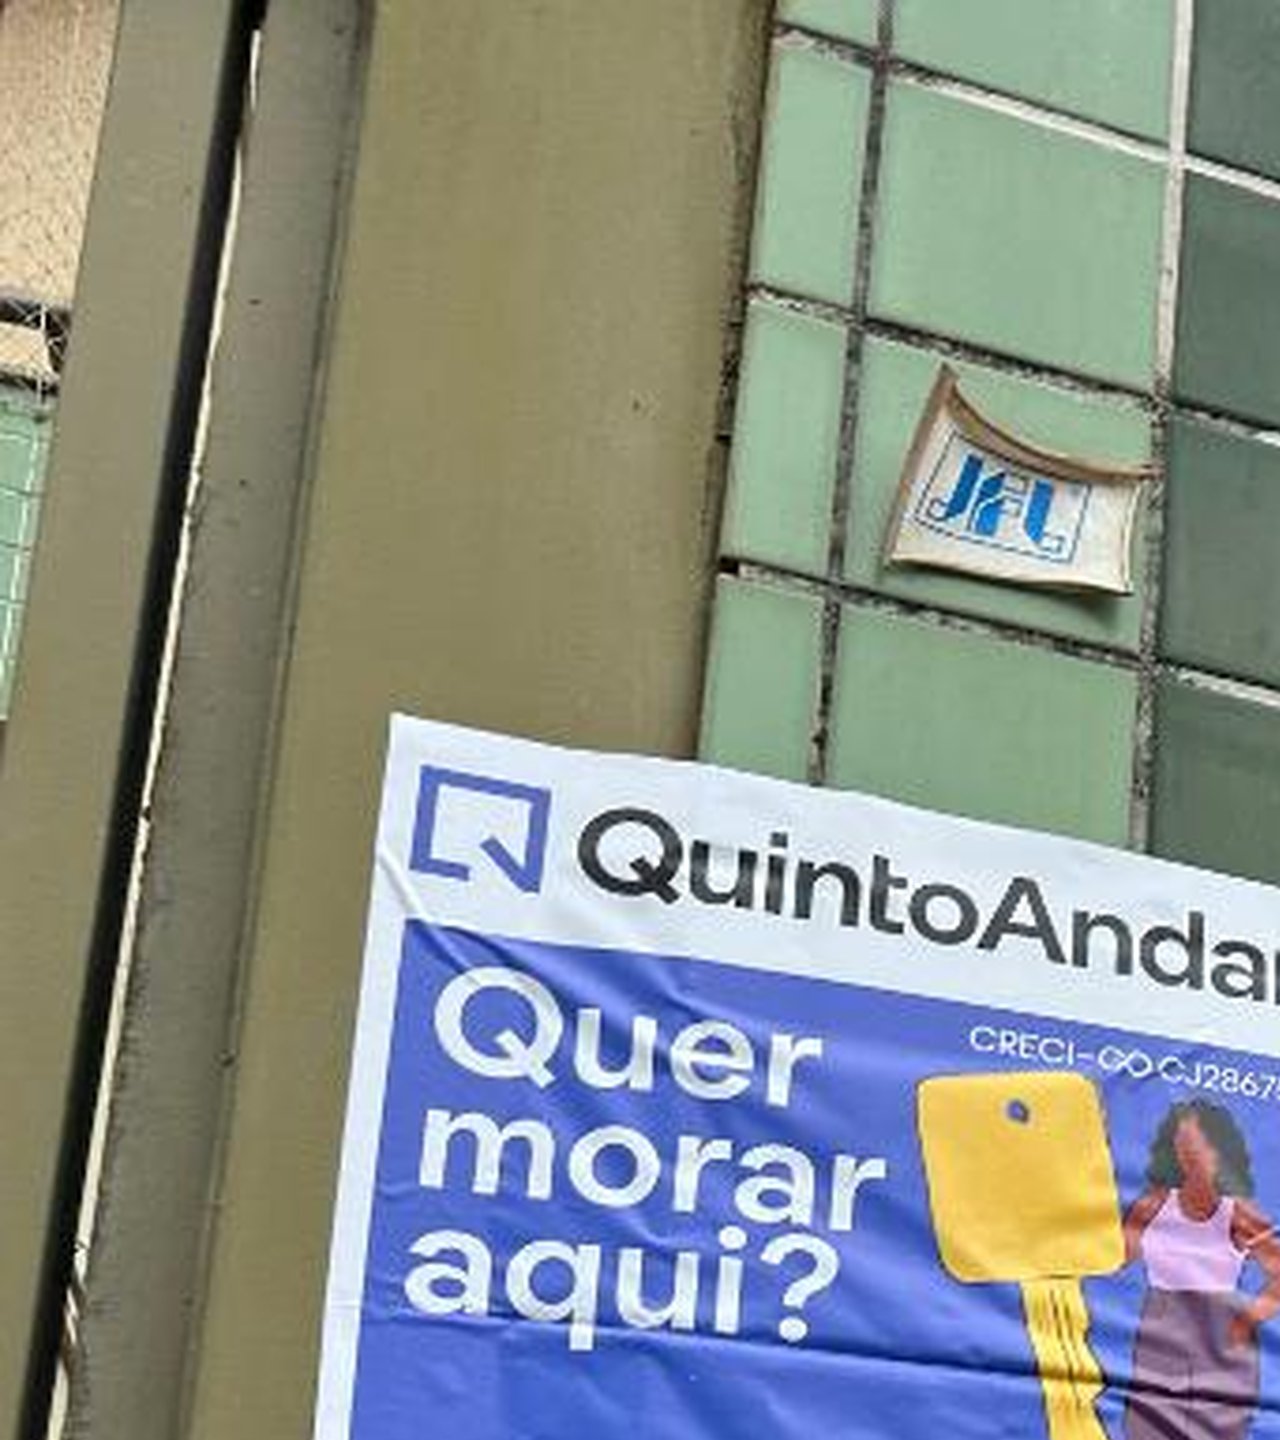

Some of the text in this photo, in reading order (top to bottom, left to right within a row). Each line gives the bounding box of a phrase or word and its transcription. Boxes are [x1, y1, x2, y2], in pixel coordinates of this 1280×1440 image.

[433, 965, 823, 1109] Quer
[970, 1025, 1152, 1079] CRECI-GO
[418, 1103, 888, 1233] morar
[403, 1226, 840, 1352] aqui?
